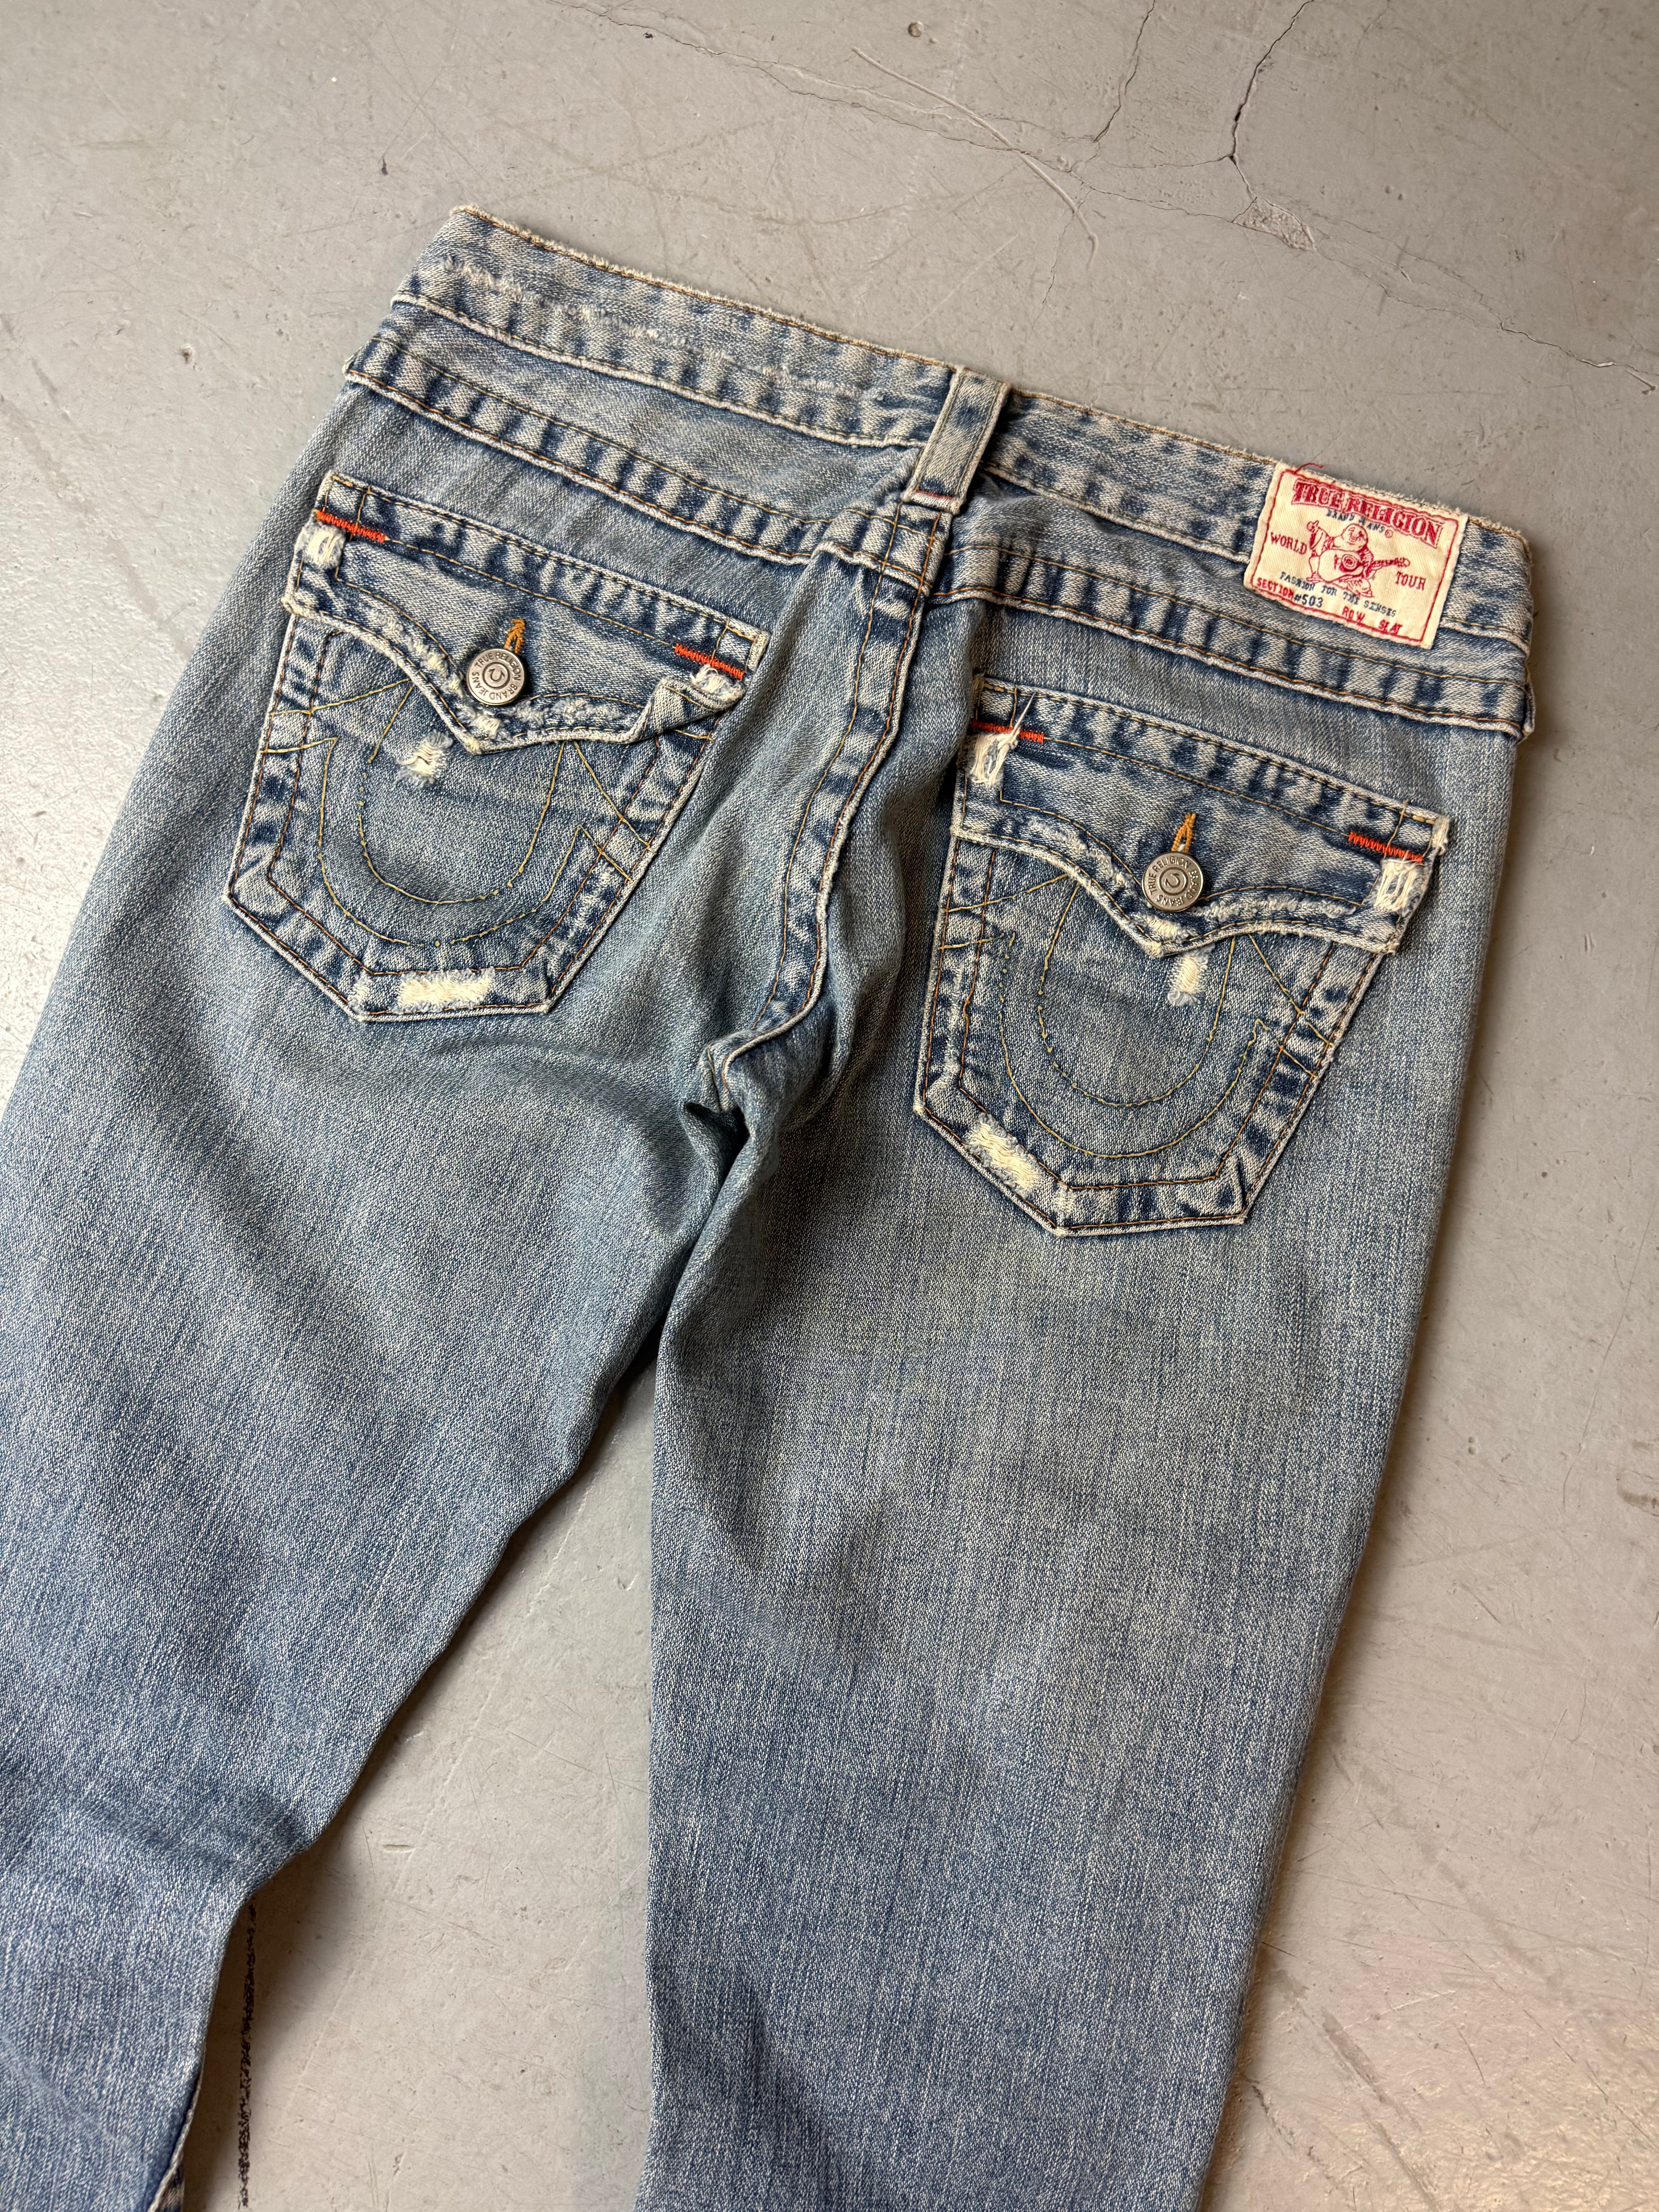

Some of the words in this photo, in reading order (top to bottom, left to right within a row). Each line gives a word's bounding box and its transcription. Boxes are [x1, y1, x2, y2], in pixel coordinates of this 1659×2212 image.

[1293, 480, 1341, 510] TRUE
[1345, 496, 1442, 546] RELIGION
[1326, 509, 1355, 521] BRAND
[1271, 532, 1307, 556] WORLD
[1395, 571, 1427, 591] TOUR
[1280, 571, 1316, 591] FASHION
[1321, 585, 1337, 597] FOR
[1343, 591, 1360, 606] THE
[1363, 600, 1397, 617] SENSES
[1341, 606, 1366, 624] ROW
[1378, 620, 1403, 635] SEAT
[474, 652, 493, 668] TRUE
[495, 652, 522, 681] RELIGION
[472, 671, 489, 697] JEANS
[489, 683, 518, 700] BRAND
[1152, 856, 1191, 872] RELIGION
[1147, 873, 1157, 895] TRUE
[1184, 869, 1199, 899] BRAND
[1155, 894, 1184, 906] JEANS
